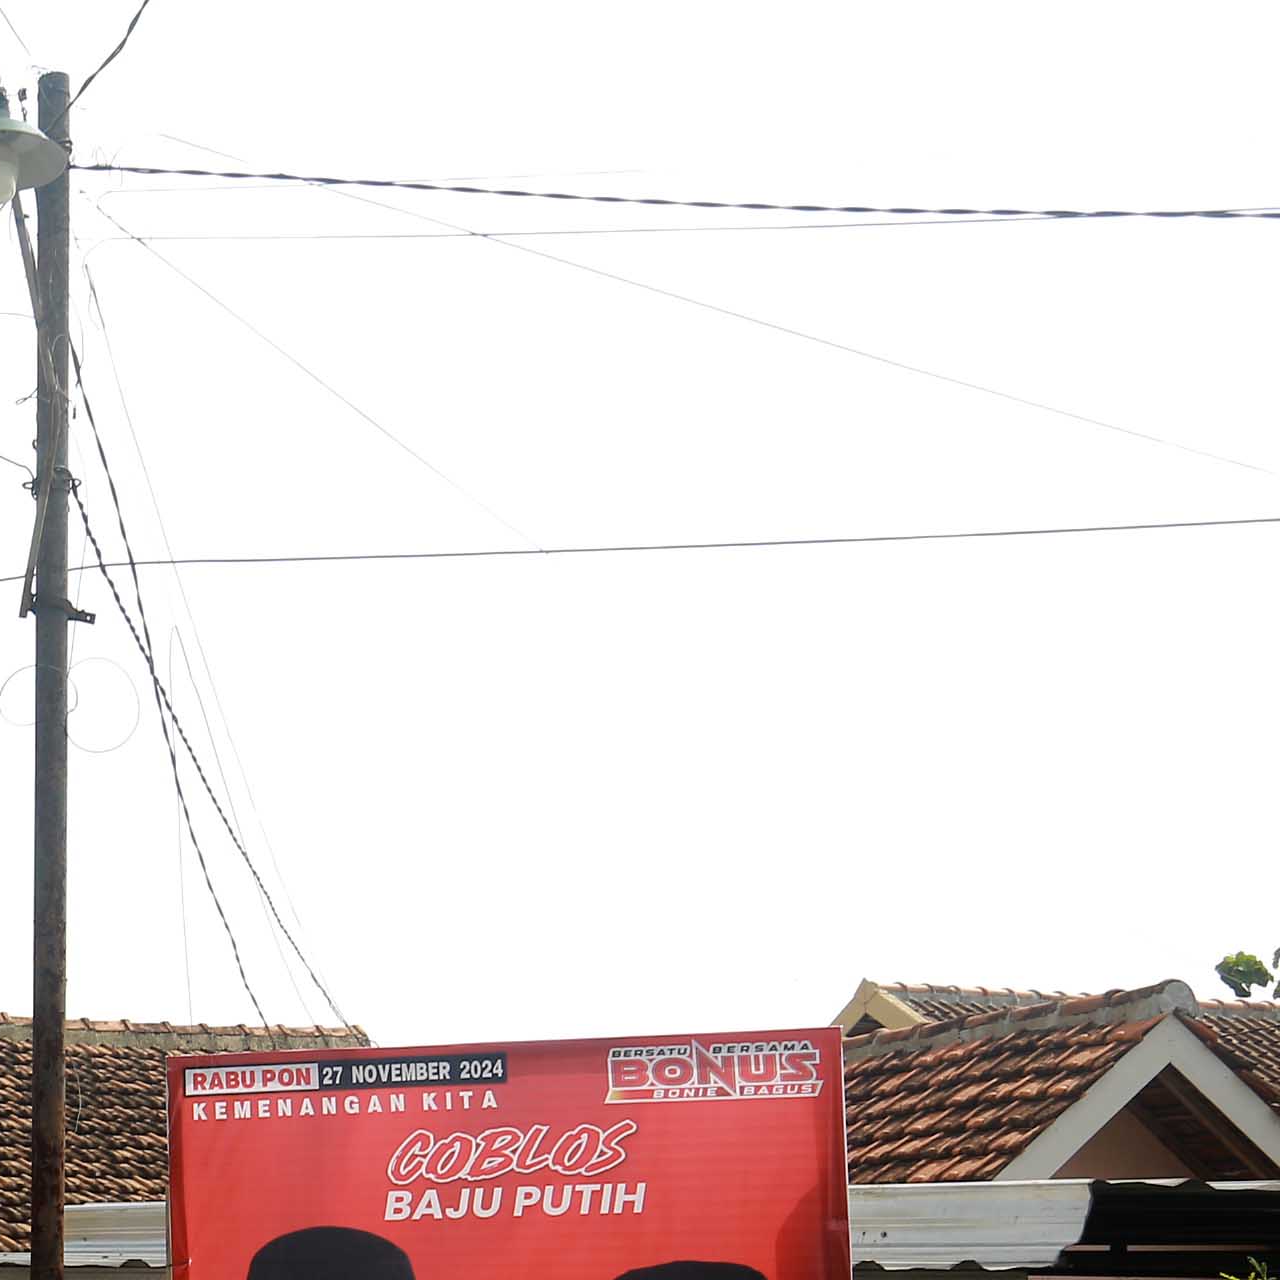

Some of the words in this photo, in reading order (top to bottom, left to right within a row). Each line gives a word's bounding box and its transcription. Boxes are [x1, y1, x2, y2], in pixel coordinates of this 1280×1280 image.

[611, 1047, 688, 1058] BERSATU
[712, 1043, 810, 1055] BERSAMA
[192, 1070, 257, 1093] RABU
[261, 1066, 312, 1089] PON
[323, 1064, 344, 1084] 27
[351, 1060, 450, 1083] NOVEMBER
[460, 1059, 503, 1079] 2024
[611, 1042, 819, 1095] BONUS
[192, 1095, 406, 1121] KEMENANGAN
[423, 1090, 498, 1111] KITA
[653, 1088, 718, 1098] BONIE
[743, 1084, 813, 1095] BAGUS
[386, 1120, 637, 1185] COBLOS
[384, 1187, 502, 1222] BAJU
[513, 1183, 646, 1218] PUTIH
